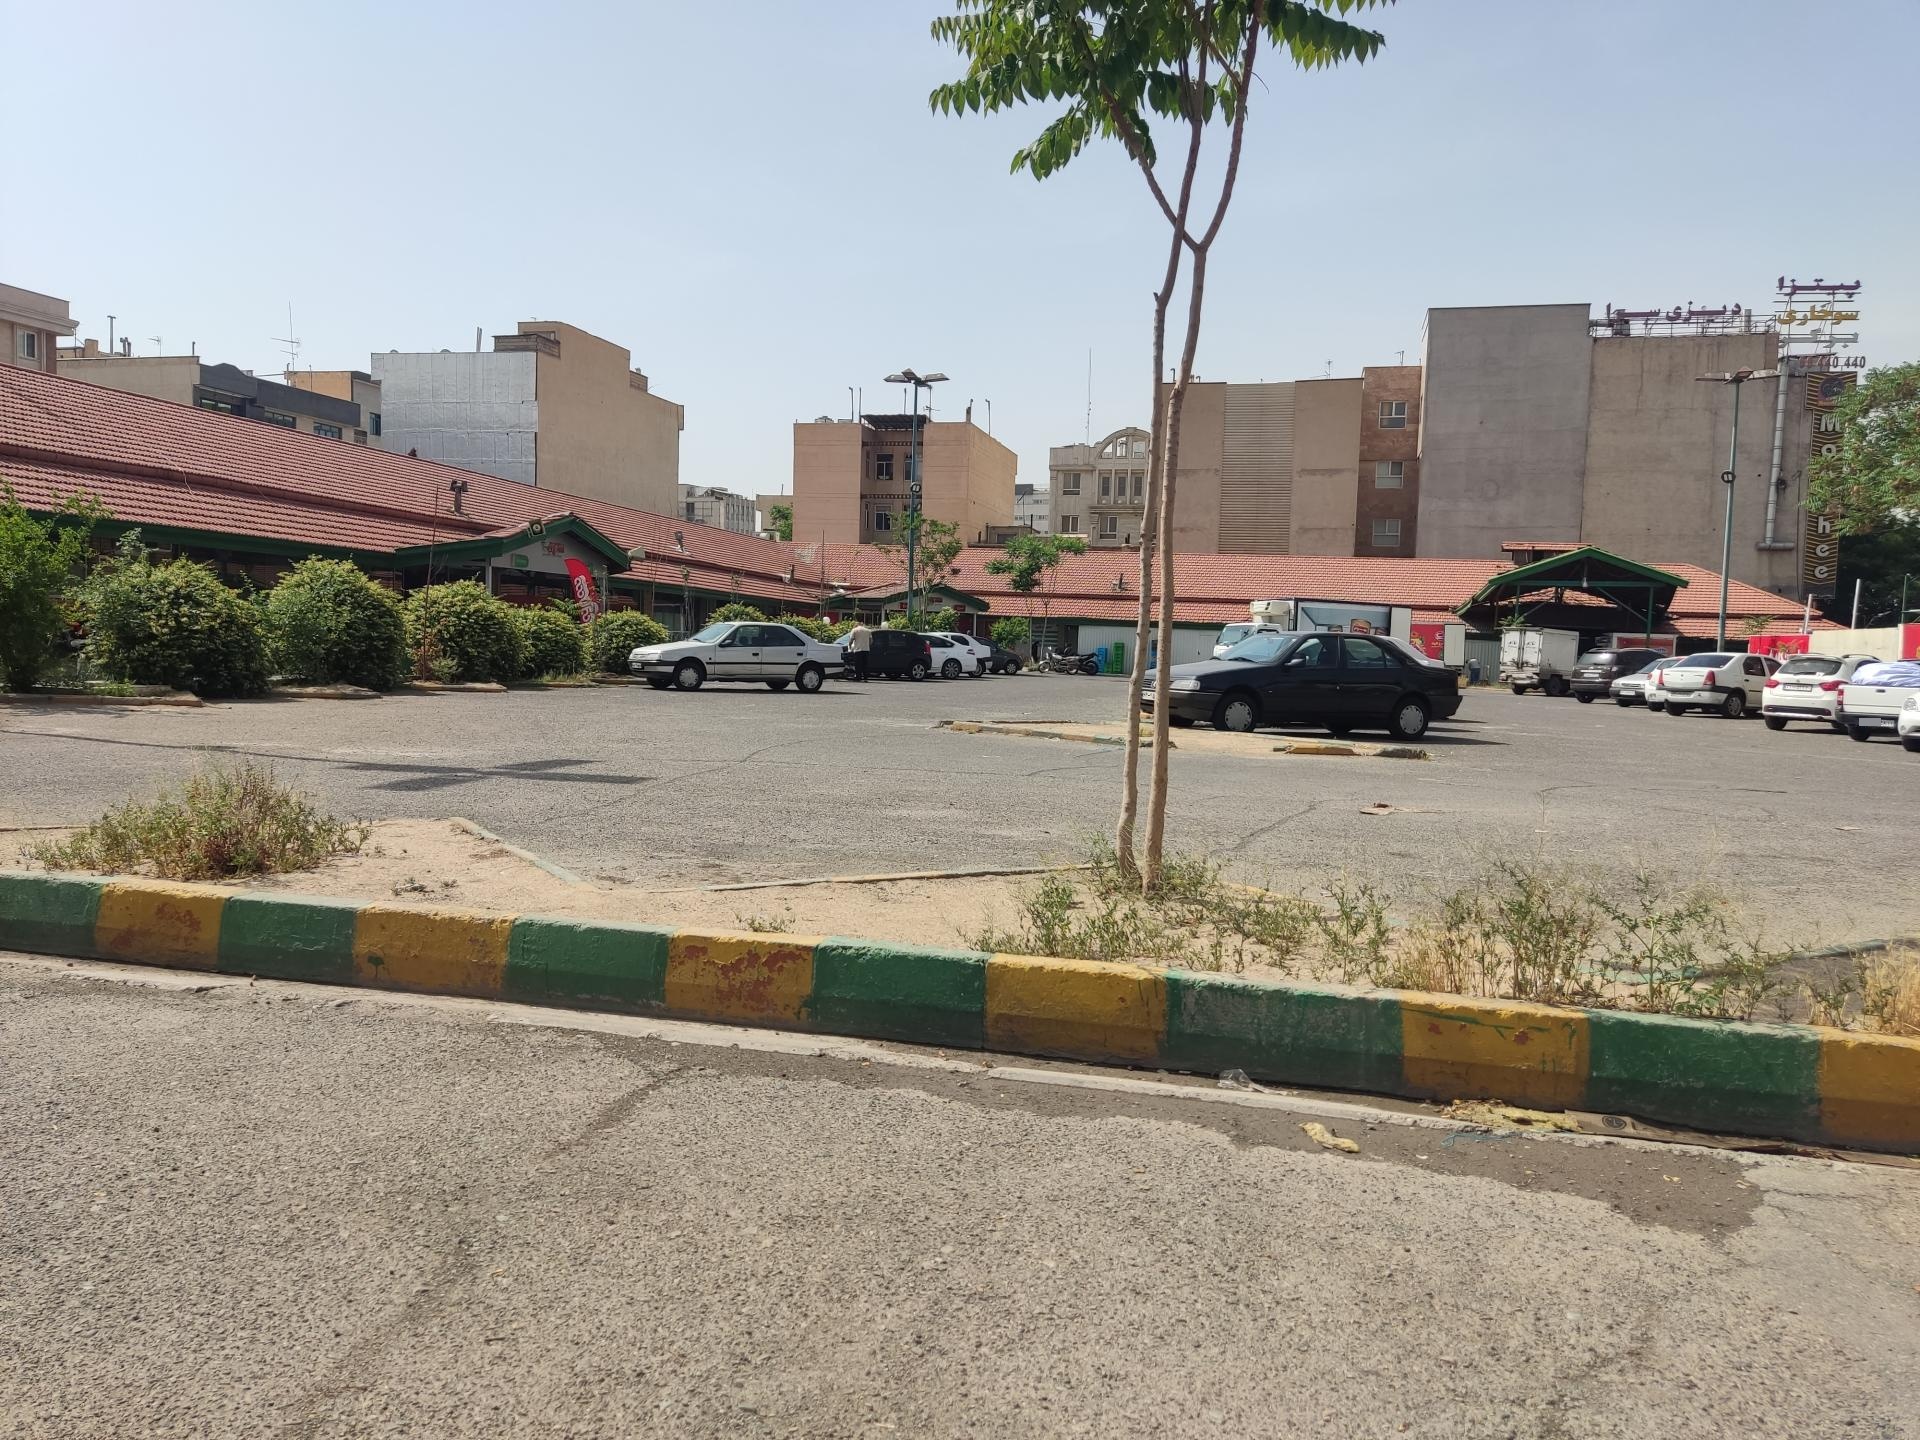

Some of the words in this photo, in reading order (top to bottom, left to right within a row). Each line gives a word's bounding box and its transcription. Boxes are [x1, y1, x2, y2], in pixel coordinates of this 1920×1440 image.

[1777, 275, 1861, 298] پیتزا
[1777, 302, 1859, 326] سوخاری
[1778, 328, 1859, 349] برگر
[1844, 356, 1866, 369] 440
[1813, 413, 1841, 579] Mohee
